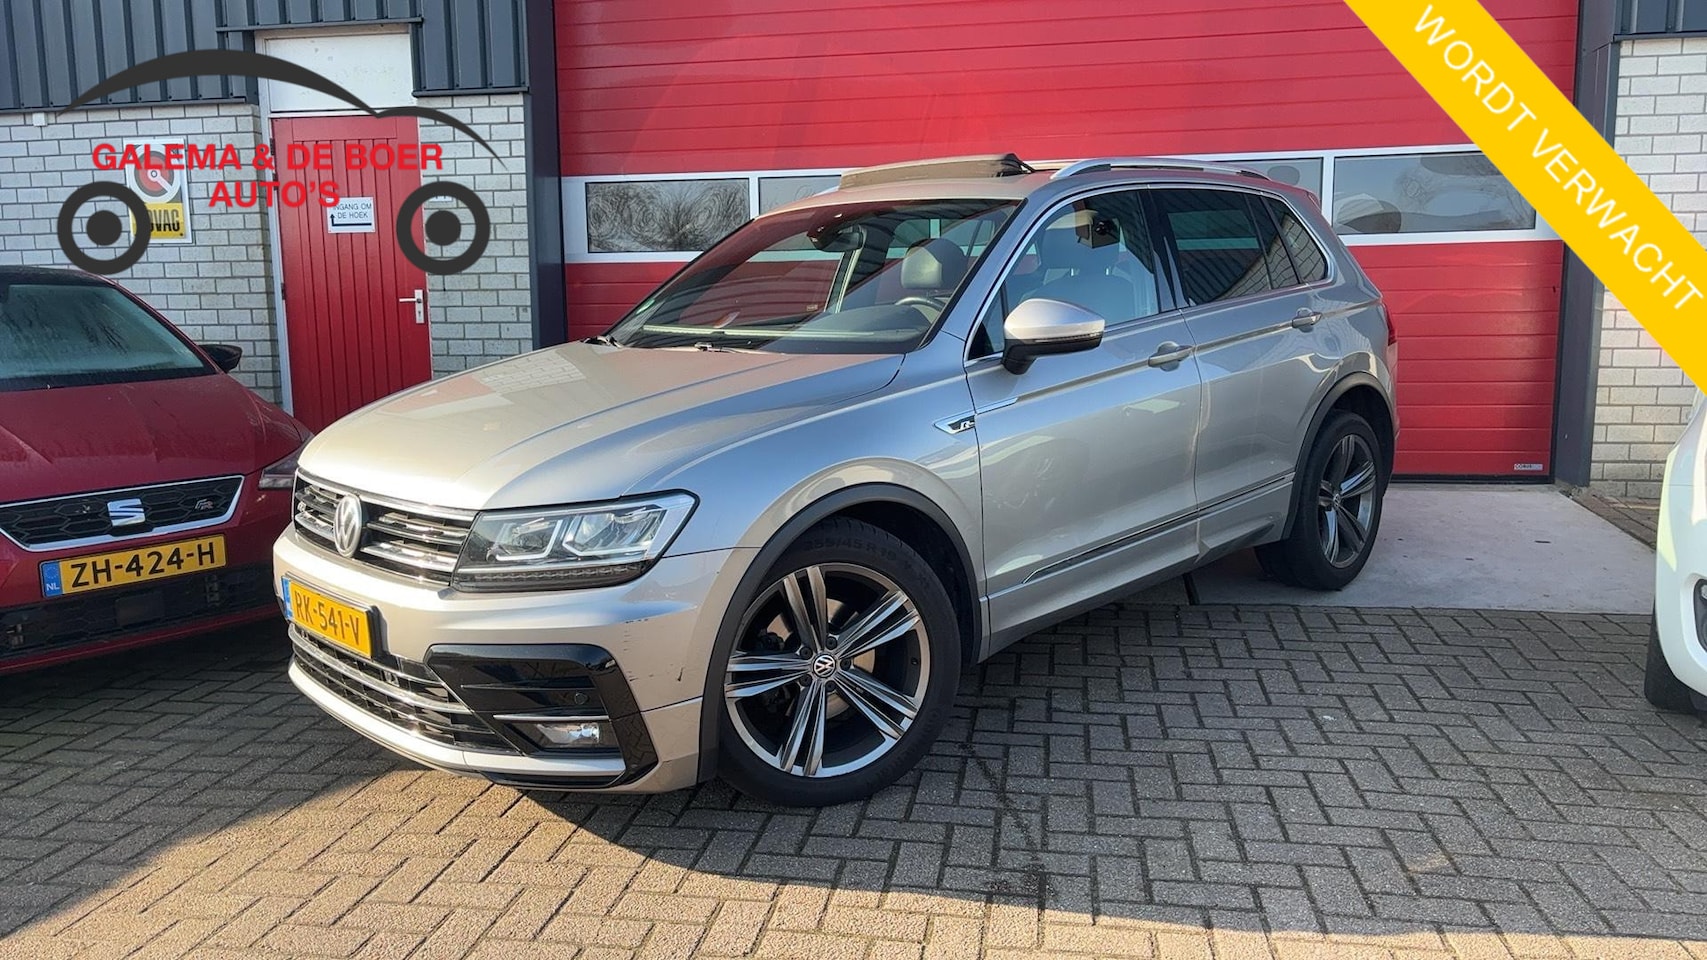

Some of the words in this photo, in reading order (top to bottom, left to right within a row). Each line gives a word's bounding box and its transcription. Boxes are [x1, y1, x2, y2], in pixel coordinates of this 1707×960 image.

[46, 582, 60, 591] NL
[71, 542, 214, 588] ZH-424-H
[294, 590, 360, 646] RK-541-V
